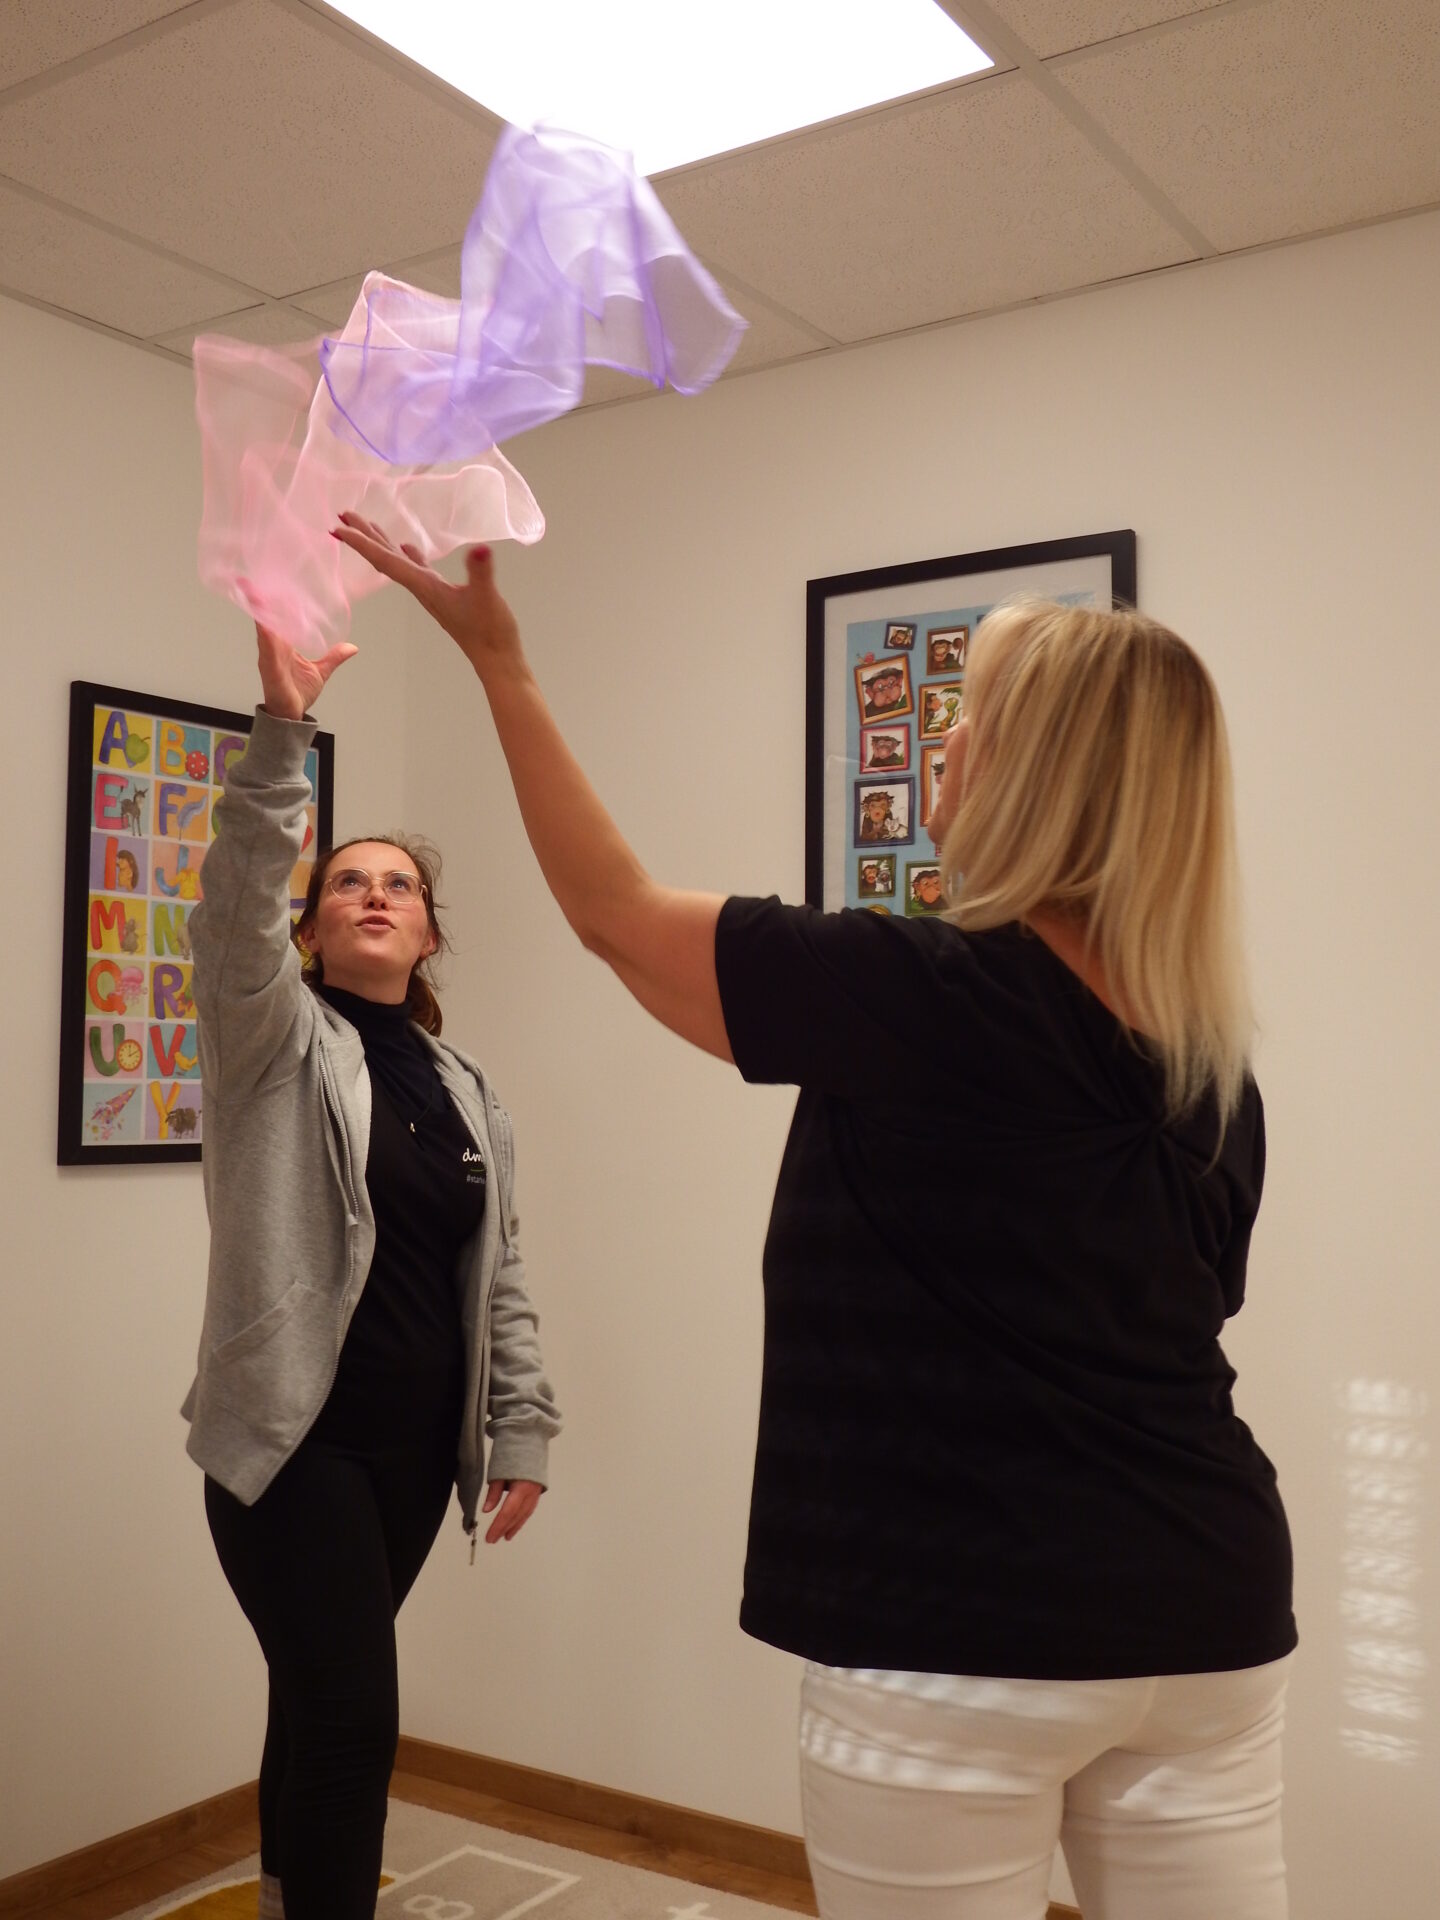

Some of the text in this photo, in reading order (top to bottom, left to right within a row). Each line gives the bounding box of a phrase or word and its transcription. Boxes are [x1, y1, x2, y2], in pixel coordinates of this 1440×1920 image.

[98, 711, 137, 768] A
[159, 721, 187, 776] B
[94, 773, 187, 835] E F
[155, 844, 189, 897] J
[90, 900, 186, 956] M N
[88, 959, 187, 1020] Q R
[89, 1023, 187, 1077] U V
[150, 1081, 181, 1139] Y
